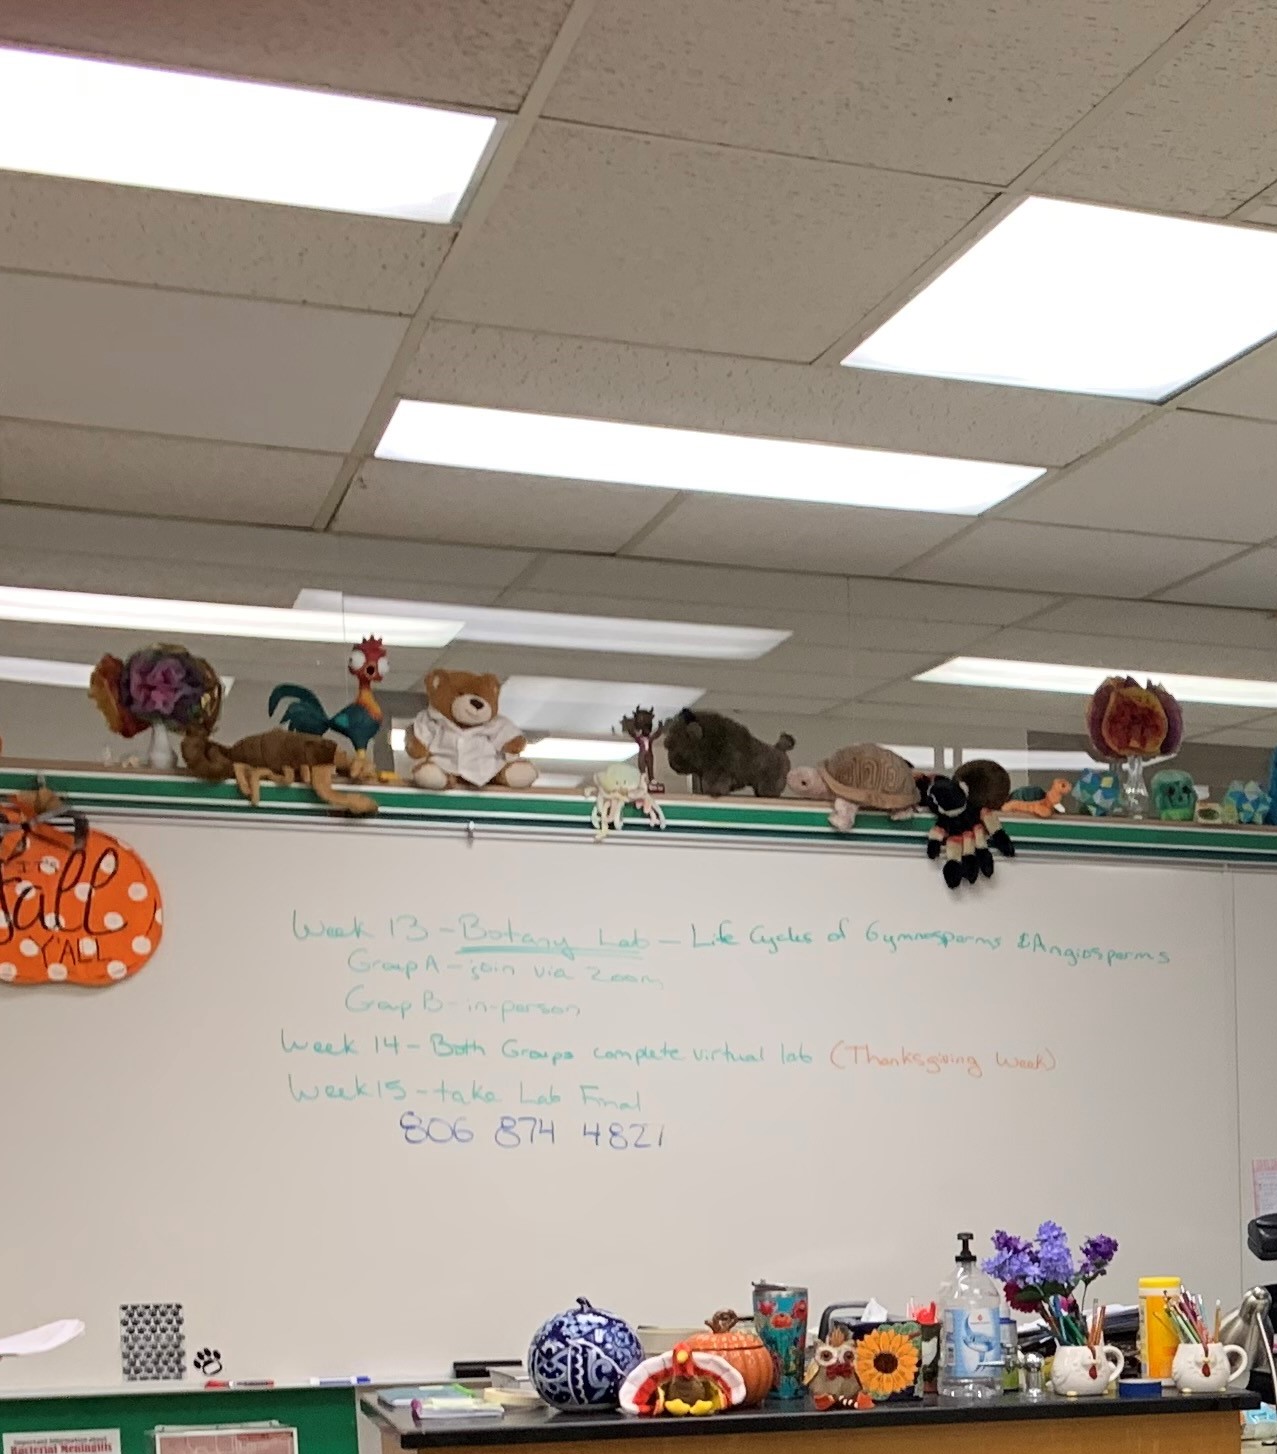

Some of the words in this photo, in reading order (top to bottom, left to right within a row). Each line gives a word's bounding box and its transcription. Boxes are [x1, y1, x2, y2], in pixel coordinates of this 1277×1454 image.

[292, 909, 374, 941] Week
[390, 914, 428, 941] 13
[458, 913, 577, 961] Botany
[599, 927, 650, 948] Lab
[691, 919, 739, 948] Life
[749, 924, 814, 954] Cycles
[827, 917, 850, 942] of
[347, 947, 419, 980] Group
[425, 954, 441, 974] A
[470, 960, 515, 982] join
[533, 965, 575, 980] via
[344, 985, 413, 1020] Group
[280, 1028, 357, 1055] Week
[374, 1034, 400, 1055] 14
[429, 1033, 487, 1057] Both
[501, 1039, 575, 1066] Groups
[593, 1042, 684, 1066] complete
[693, 1042, 765, 1064] virtual
[781, 1042, 813, 1065] lab
[829, 1040, 984, 1078] (Thanksgiving
[287, 1073, 367, 1103] Week
[433, 1079, 496, 1105] take
[519, 1080, 561, 1105] Lab
[579, 1084, 643, 1113] Final
[400, 1110, 475, 1144] 806
[494, 1115, 556, 1149] 874
[582, 1121, 666, 1149] 4821
[60, 1443, 112, 1453] Meningitis
